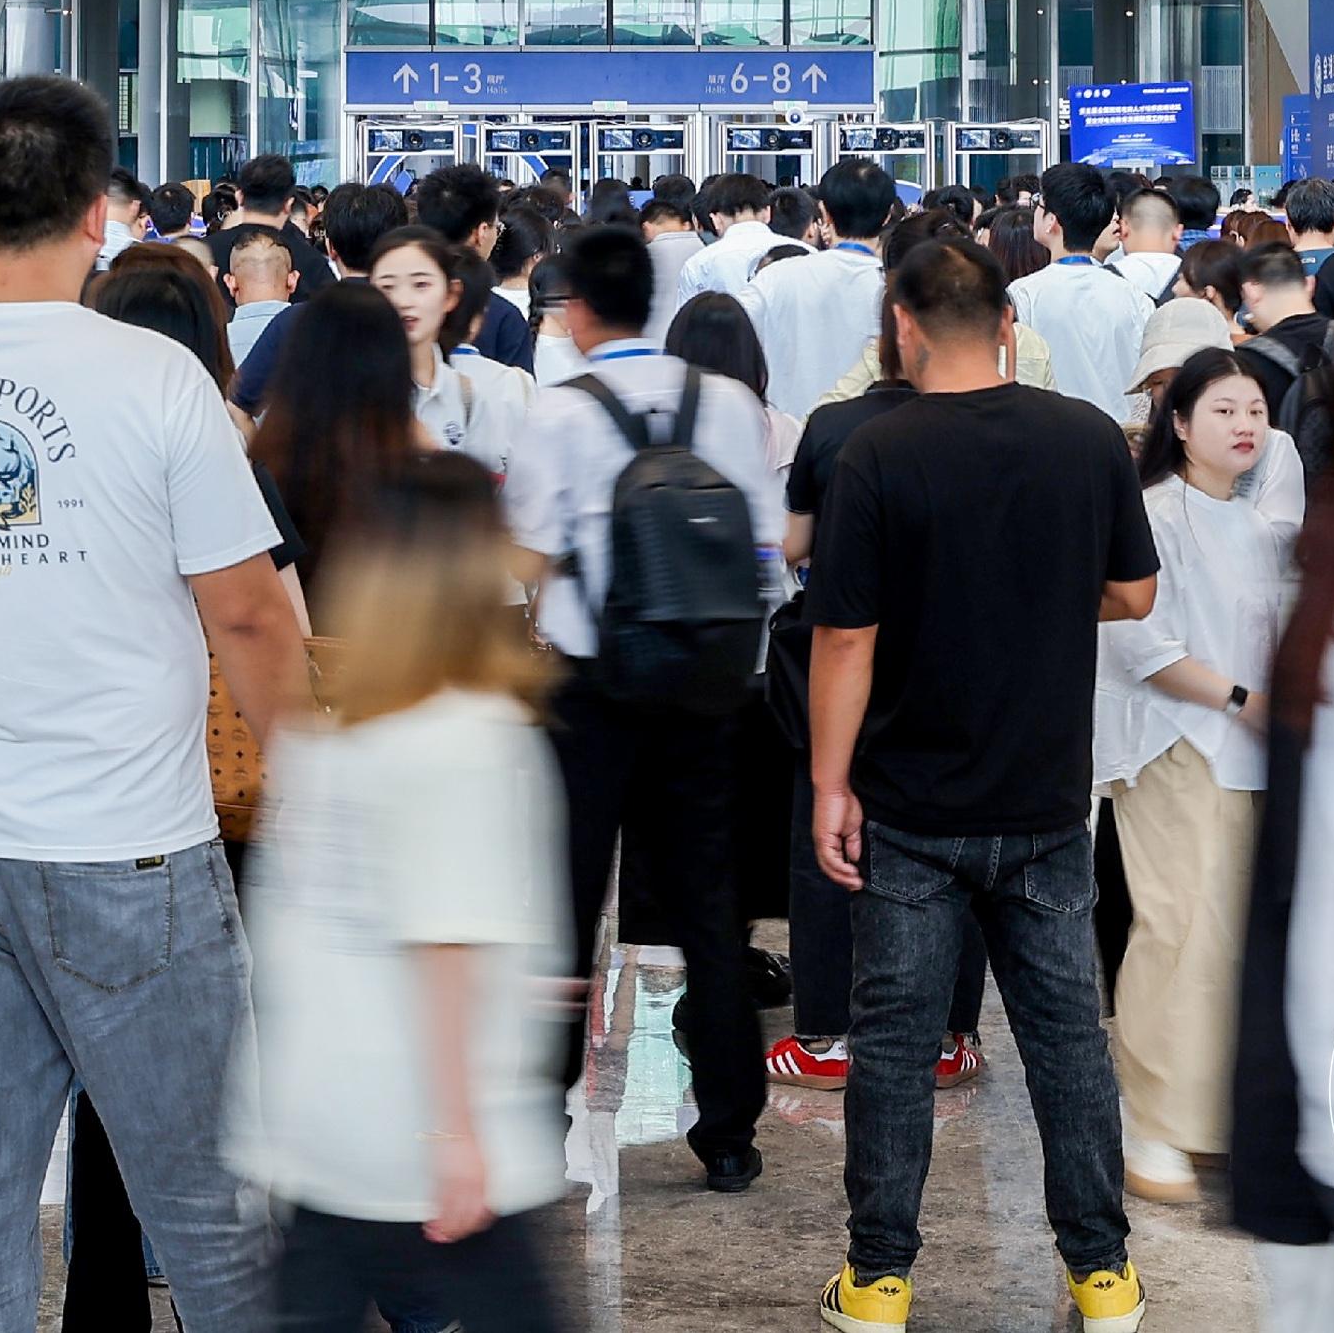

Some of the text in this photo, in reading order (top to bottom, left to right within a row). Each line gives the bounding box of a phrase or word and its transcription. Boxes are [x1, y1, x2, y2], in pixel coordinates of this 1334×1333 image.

[429, 62, 482, 94] 1-3
[731, 62, 791, 94] 6-8
[57, 499, 84, 508] 1991
[1, 550, 88, 566] HEART
